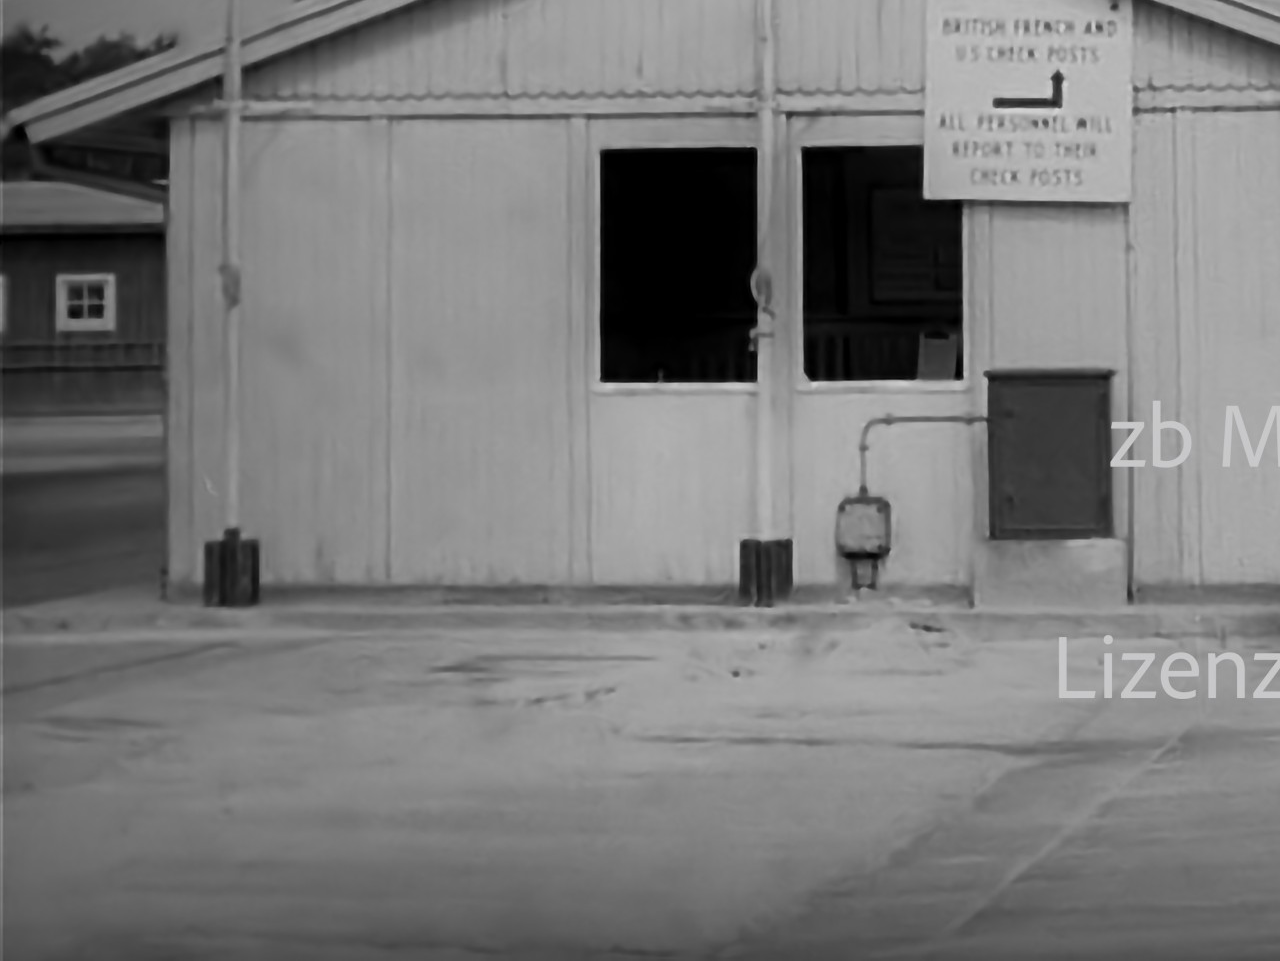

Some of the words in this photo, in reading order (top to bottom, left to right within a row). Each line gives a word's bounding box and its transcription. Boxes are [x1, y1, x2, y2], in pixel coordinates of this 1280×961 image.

[942, 18, 1005, 36] BRITISH
[1014, 18, 1075, 37] FRENCH
[1084, 19, 1117, 37] AND
[986, 44, 1039, 64] CHECK
[1047, 45, 1101, 64] POSTS
[939, 114, 965, 132] ALL
[977, 114, 1070, 134] PERSONNEL
[952, 141, 1013, 158] REPORT
[1024, 141, 1045, 159] TO
[1054, 142, 1097, 159] THEIR
[970, 168, 1019, 187] CHECK
[1030, 168, 1083, 187] POSTS
